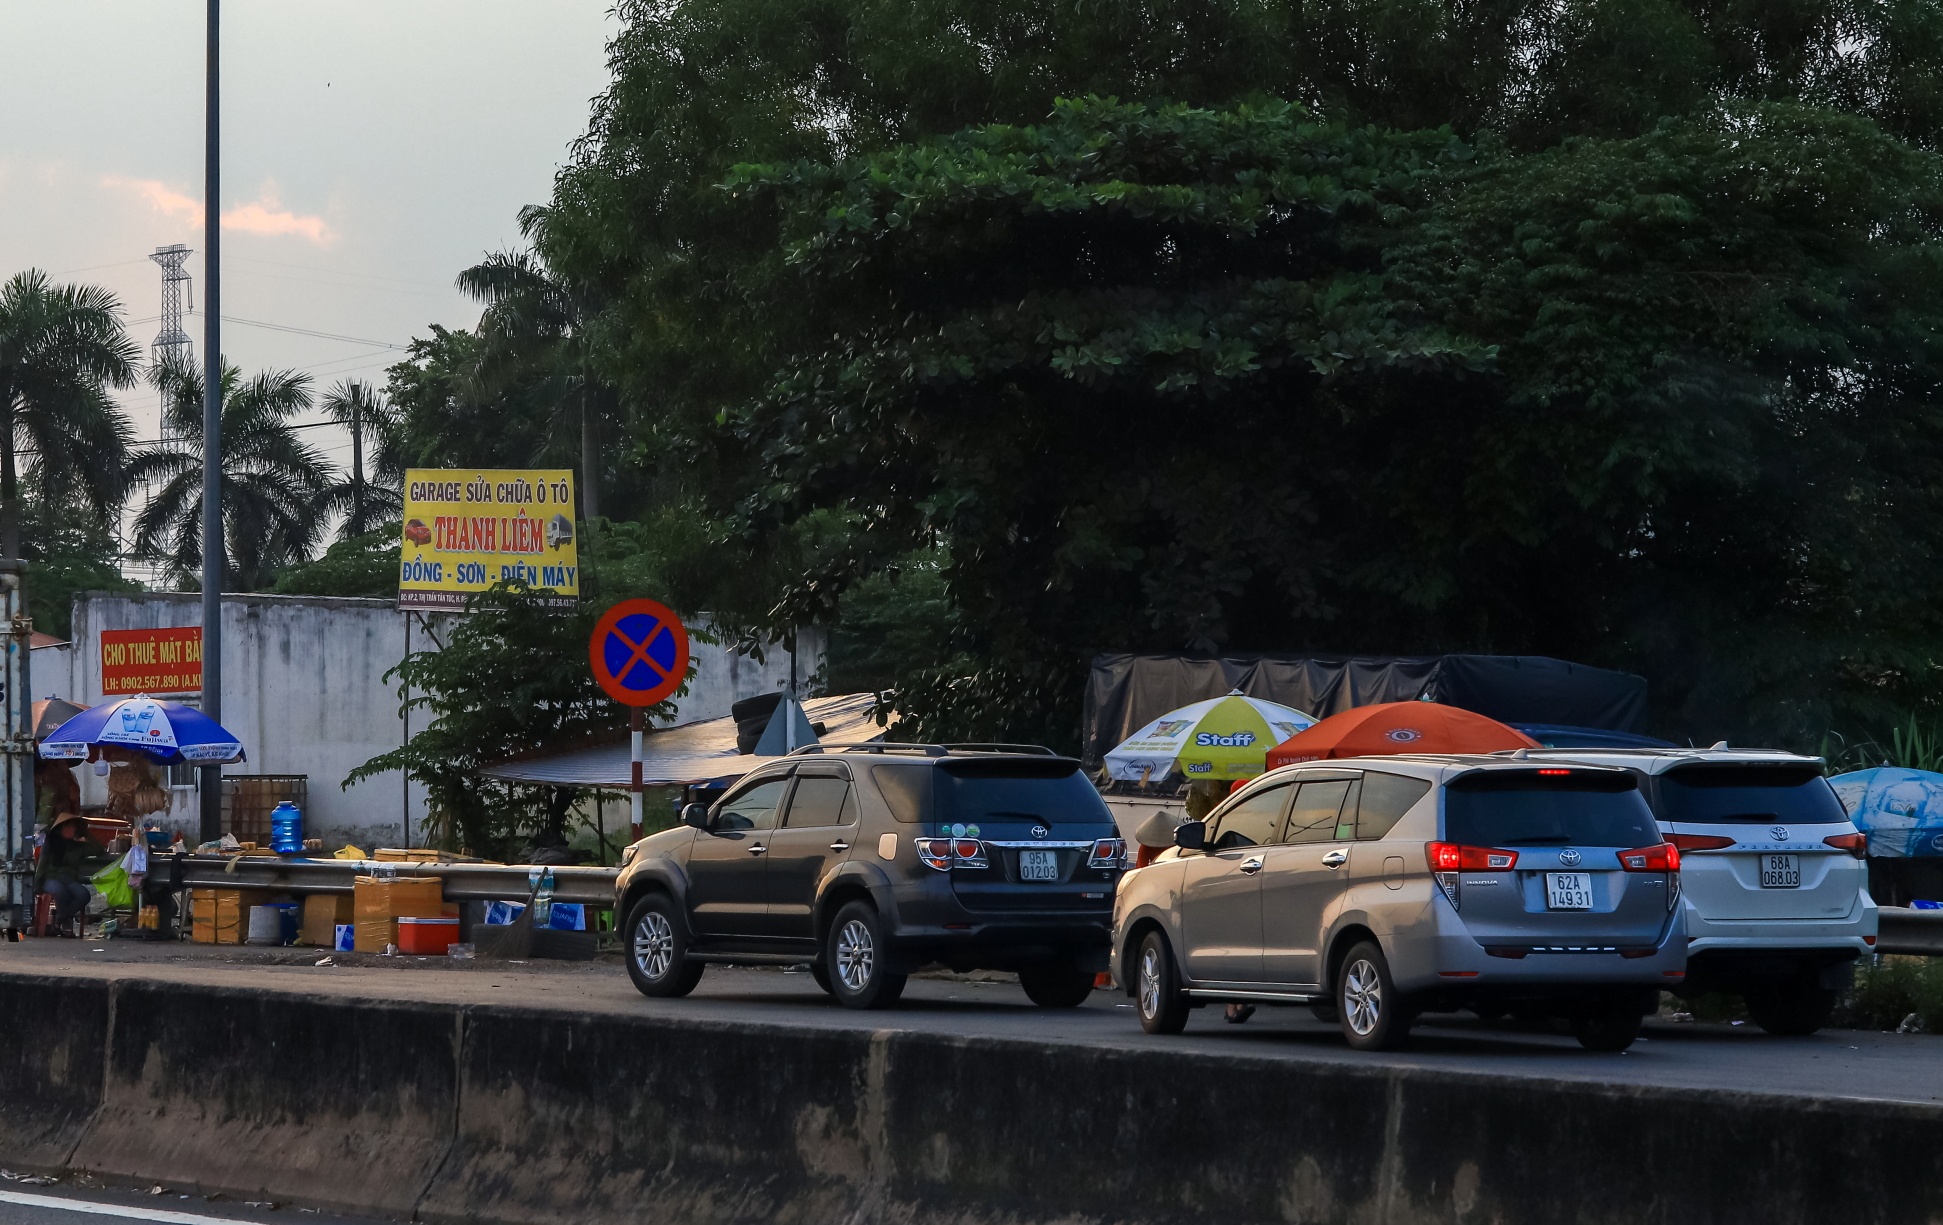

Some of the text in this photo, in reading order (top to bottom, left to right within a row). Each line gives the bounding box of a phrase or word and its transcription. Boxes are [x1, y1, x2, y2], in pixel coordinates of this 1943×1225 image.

[410, 475, 569, 504] GARAGE SỬA CHỮA Ô TÔ
[434, 507, 544, 553] THANH LIÊM
[402, 554, 442, 583] ĐỒNG
[456, 561, 486, 584] SƠN
[542, 561, 576, 587] MÁY
[103, 643, 126, 666] CHO
[128, 636, 157, 665] THUÊ
[160, 636, 182, 668] MẶT
[105, 677, 119, 690] LH:
[121, 675, 179, 689] 0902.567.890
[141, 736, 169, 744] Fujiwa
[1196, 731, 1256, 747] Staff
[1188, 761, 1212, 773] Staff
[1029, 852, 1048, 864] 95A
[1771, 856, 1791, 870] 68A
[1557, 876, 1581, 890] 62A
[1764, 871, 1799, 885] 068.03
[1551, 891, 1590, 906] 149.31
